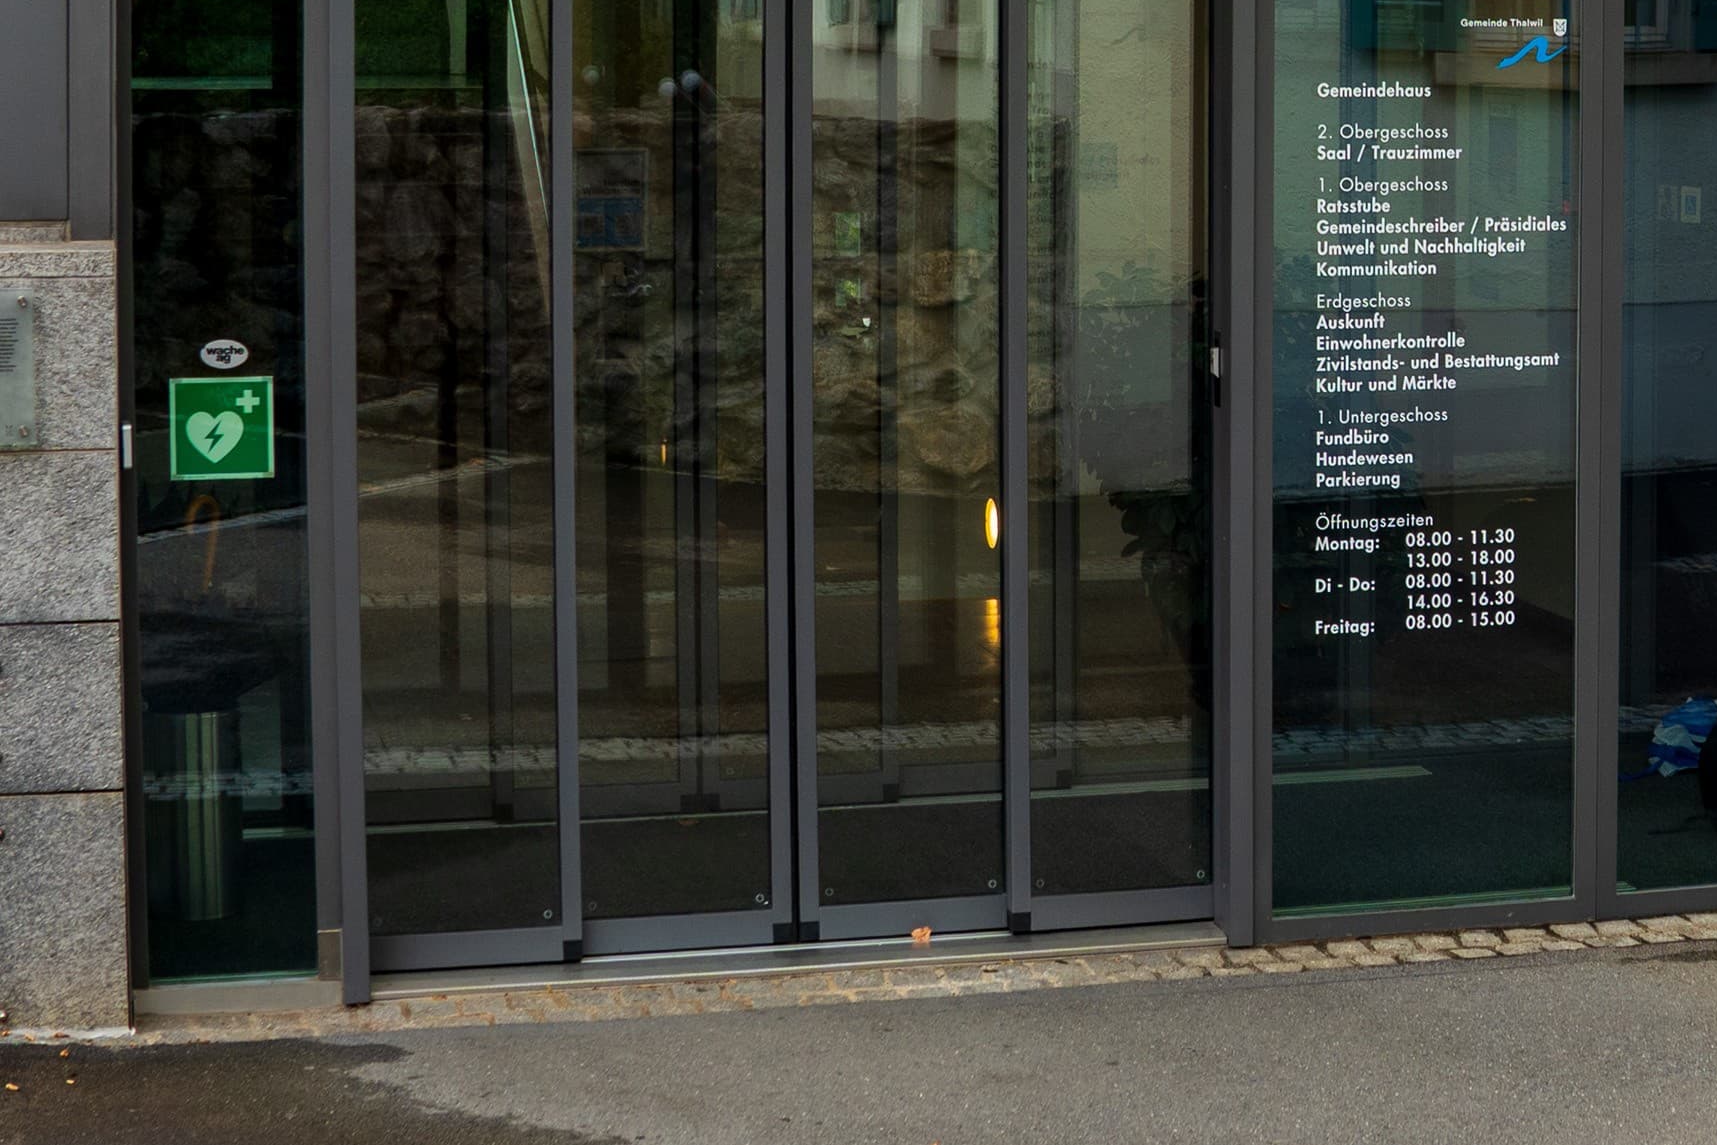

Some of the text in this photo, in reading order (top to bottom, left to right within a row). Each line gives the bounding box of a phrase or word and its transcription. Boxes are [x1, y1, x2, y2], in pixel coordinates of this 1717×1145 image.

[1461, 19, 1543, 27] Gemeinde Thalwil
[1318, 81, 1431, 97] Gemeindehaus
[1318, 123, 1448, 142] 2. Obergeschoss
[1318, 144, 1462, 162] Saal / Trauzimmer
[1320, 176, 1448, 195] 1. Obergeschoss
[1318, 197, 1390, 213] Ratsstube
[1317, 215, 1566, 234] Gemeindeschreiber / Präsidiales
[1318, 237, 1525, 256] Umwelt und Nachhaltigkeit
[1317, 260, 1436, 276] Kommunikation
[1317, 292, 1410, 312] Erdgeschoss
[1317, 312, 1385, 329] Auskunft
[206, 345, 245, 355] wache
[1317, 332, 1465, 350] Einwohnerkontrolle
[215, 354, 231, 364] ag
[1317, 353, 1559, 371] Zivilstands- und Bestattungsamt
[1317, 374, 1456, 392] Kultur und Märkte
[1319, 406, 1447, 426] 1. Untergeschoss
[1317, 429, 1389, 445] Fundbüro
[1317, 450, 1413, 466] Hundewesen
[1317, 471, 1400, 488] Parkierung
[1316, 512, 1433, 533] Öffnungszeiten
[1316, 537, 1379, 553] Montag:
[1406, 531, 1451, 547] 08.00
[1471, 528, 1514, 544] 11.30
[1408, 552, 1451, 567] 13.00
[1471, 549, 1514, 565] 18.00
[1316, 578, 1331, 592] Di
[1350, 577, 1375, 591] Do:
[1406, 573, 1451, 588] 08.00
[1471, 570, 1514, 585] 11.30
[1408, 593, 1451, 609] 14.00
[1471, 590, 1514, 606] 16.30
[1316, 619, 1374, 636] Freitag:
[1406, 613, 1451, 629] 08.00
[1472, 611, 1515, 626] 15.00
